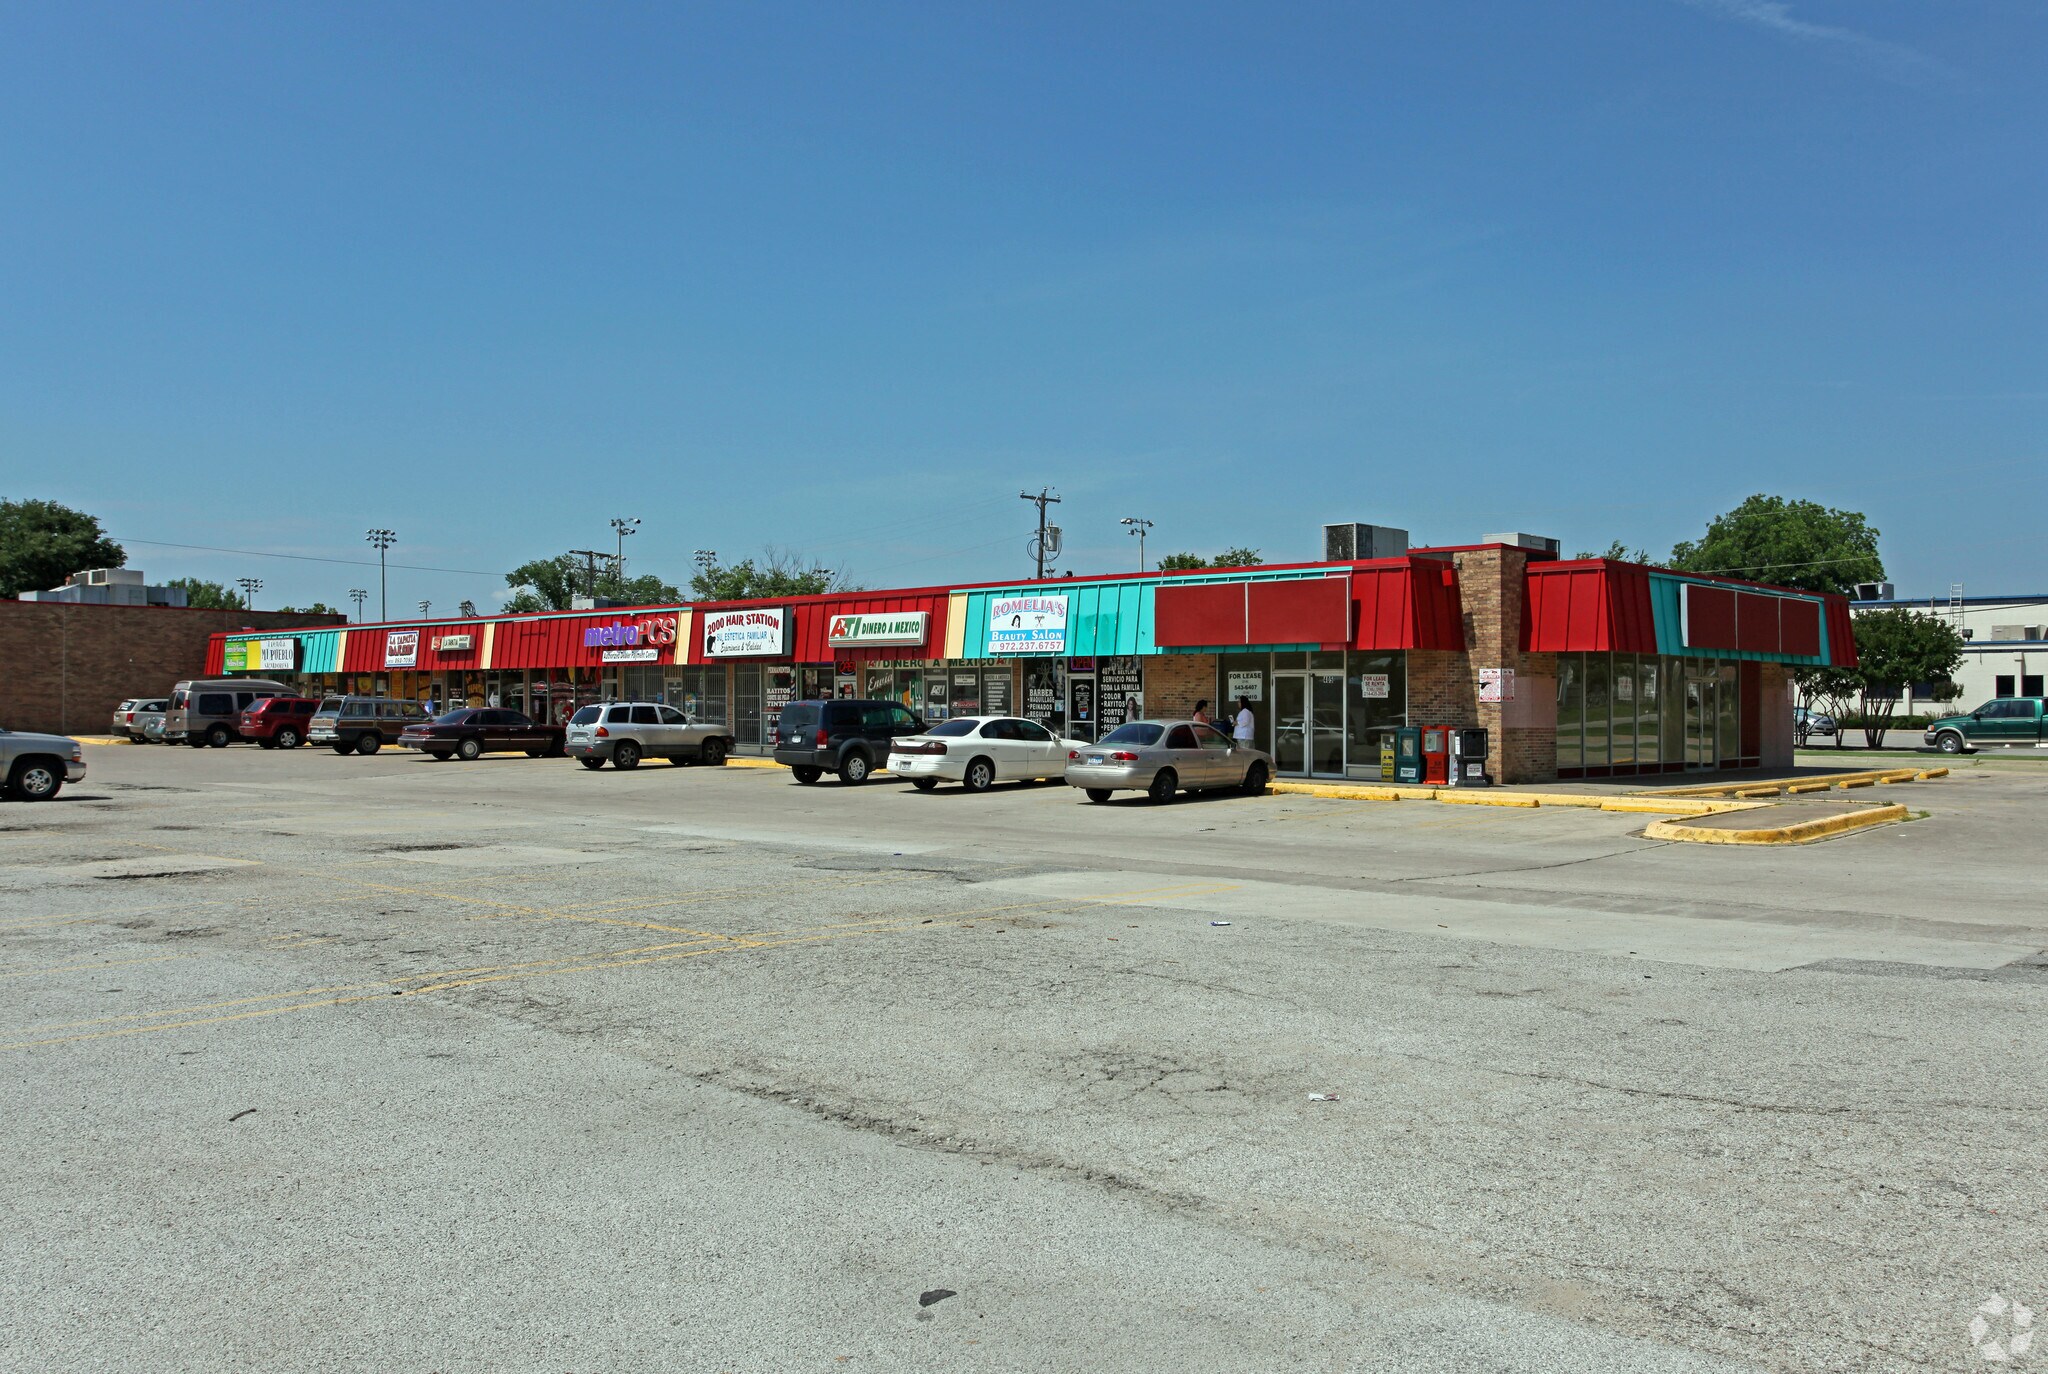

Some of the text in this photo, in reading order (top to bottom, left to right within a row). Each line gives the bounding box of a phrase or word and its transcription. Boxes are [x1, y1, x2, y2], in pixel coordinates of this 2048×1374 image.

[993, 600, 1065, 619] ROMELIA'S
[707, 613, 780, 635] 2000 HAIR STATION
[862, 622, 887, 634] DINERO
[888, 622, 893, 633] A
[894, 621, 920, 633] MEXICO
[584, 617, 676, 647] metroPCS
[725, 632, 745, 640] ESTETICA
[747, 631, 767, 640] FAMILIAR
[999, 641, 1062, 651] 972.237.6757
[261, 649, 294, 660] MI PUEBLO
[932, 659, 941, 667] A
[948, 659, 994, 667] MEXICO
[1029, 689, 1053, 697] BARBER
